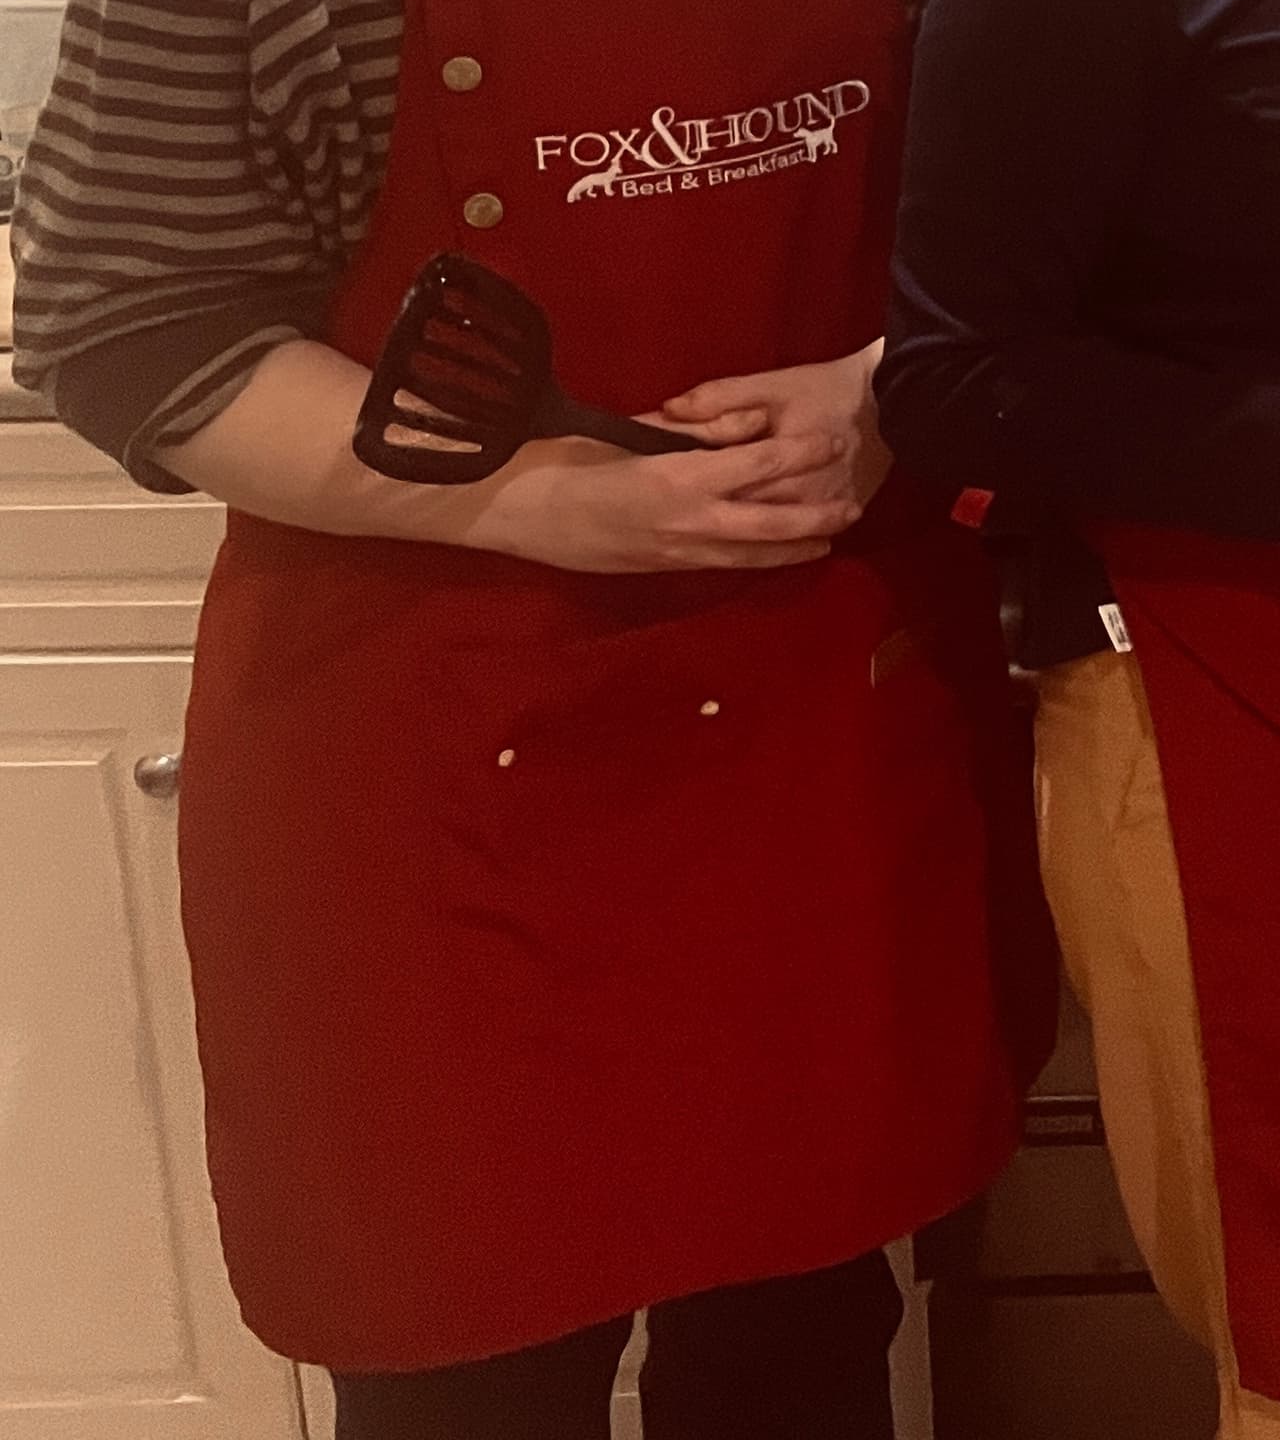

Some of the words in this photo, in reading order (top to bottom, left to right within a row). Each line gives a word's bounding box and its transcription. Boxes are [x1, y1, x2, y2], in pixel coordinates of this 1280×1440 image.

[621, 175, 673, 198] Bed
[681, 172, 699, 190] &
[707, 149, 808, 186] Breakfast
